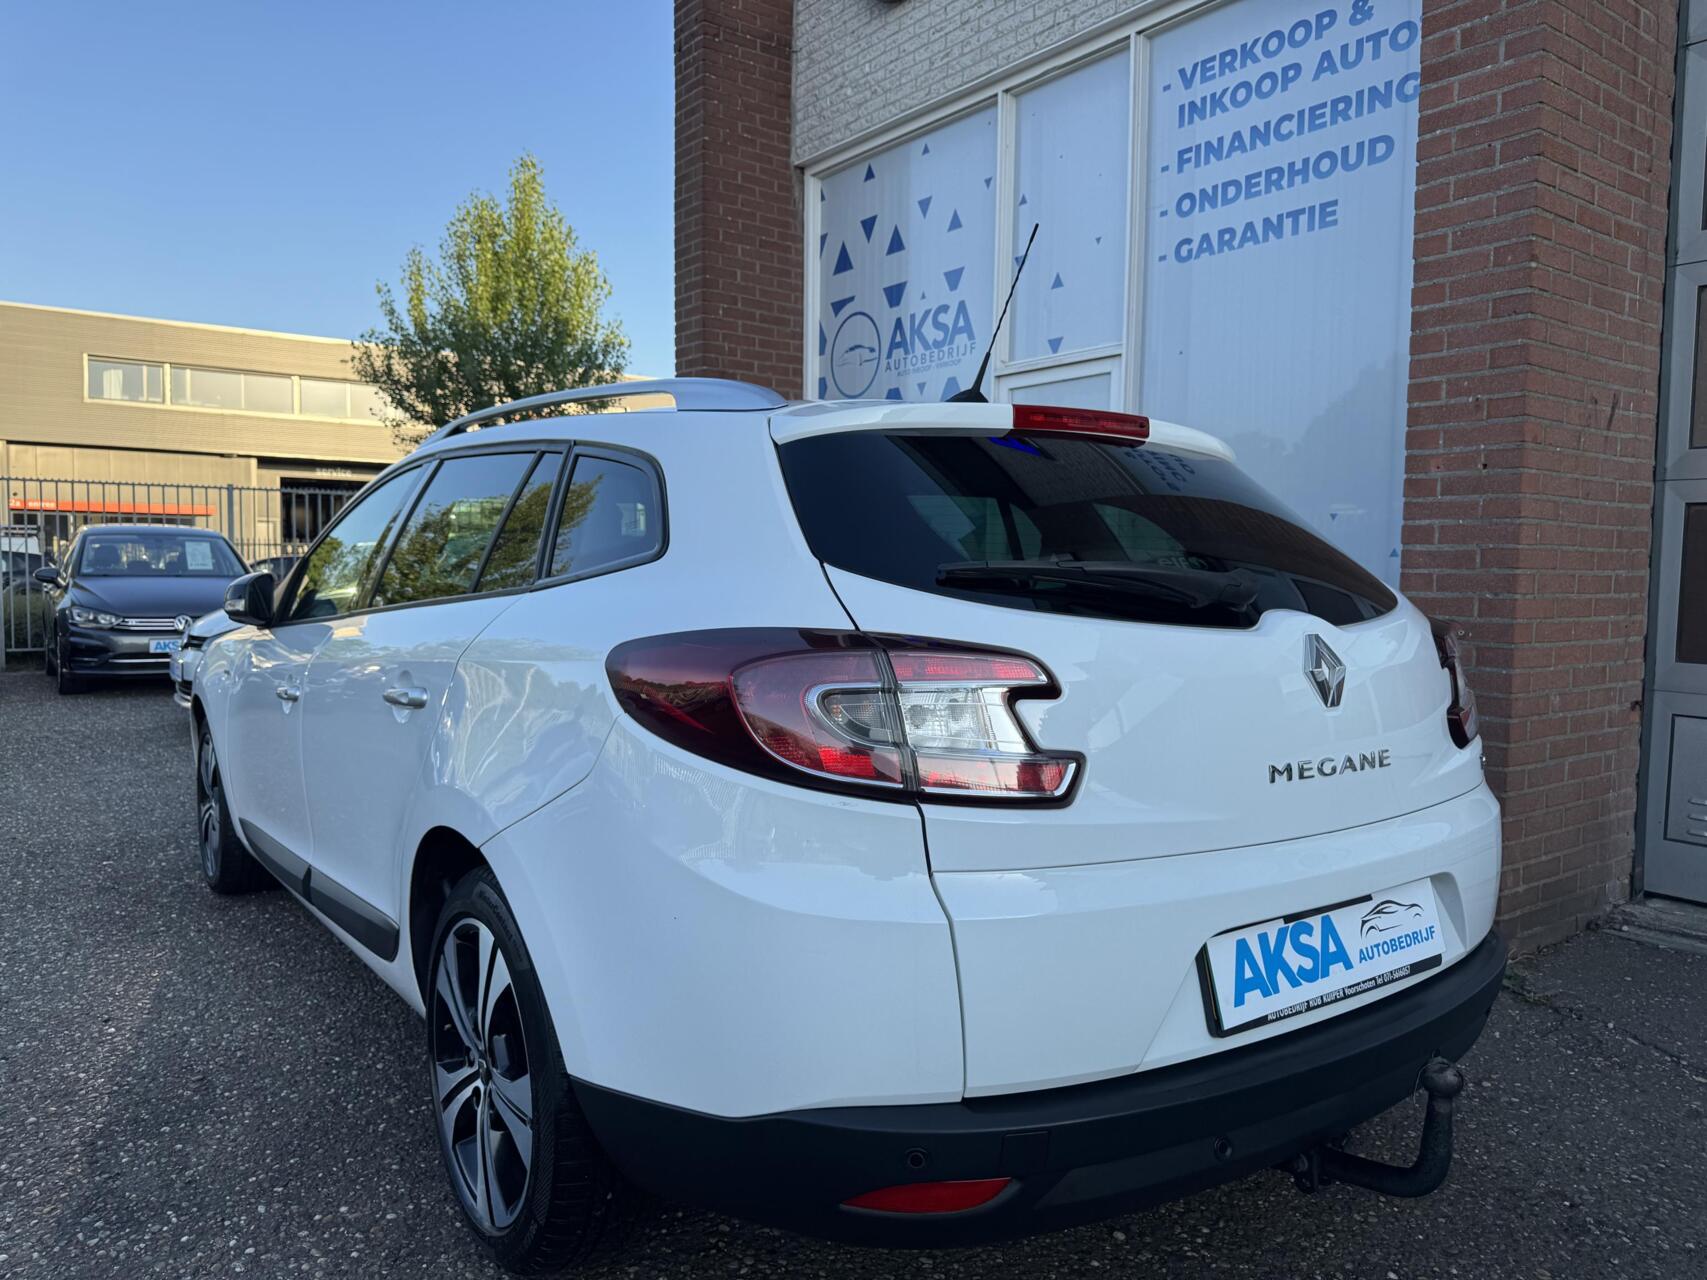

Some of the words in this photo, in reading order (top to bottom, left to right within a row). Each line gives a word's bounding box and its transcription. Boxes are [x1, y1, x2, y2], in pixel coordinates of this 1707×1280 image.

[1177, 9, 1338, 91] VERKOOP
[1348, 0, 1374, 26] &
[1177, 62, 1303, 129] INKOOP
[1312, 20, 1419, 82] AUTO
[1176, 71, 1421, 175] FINANCIERING
[1175, 134, 1395, 218] ONDERHOUD
[1174, 199, 1339, 264] GARANTIE
[884, 342, 977, 373] AUTOBEDRIJF
[886, 299, 977, 360] AKSA
[154, 640, 179, 650] AKS
[1268, 749, 1392, 784] MEGANE
[1234, 914, 1354, 1008] AKSA
[1359, 925, 1435, 964] AUTOBEDRIJF
